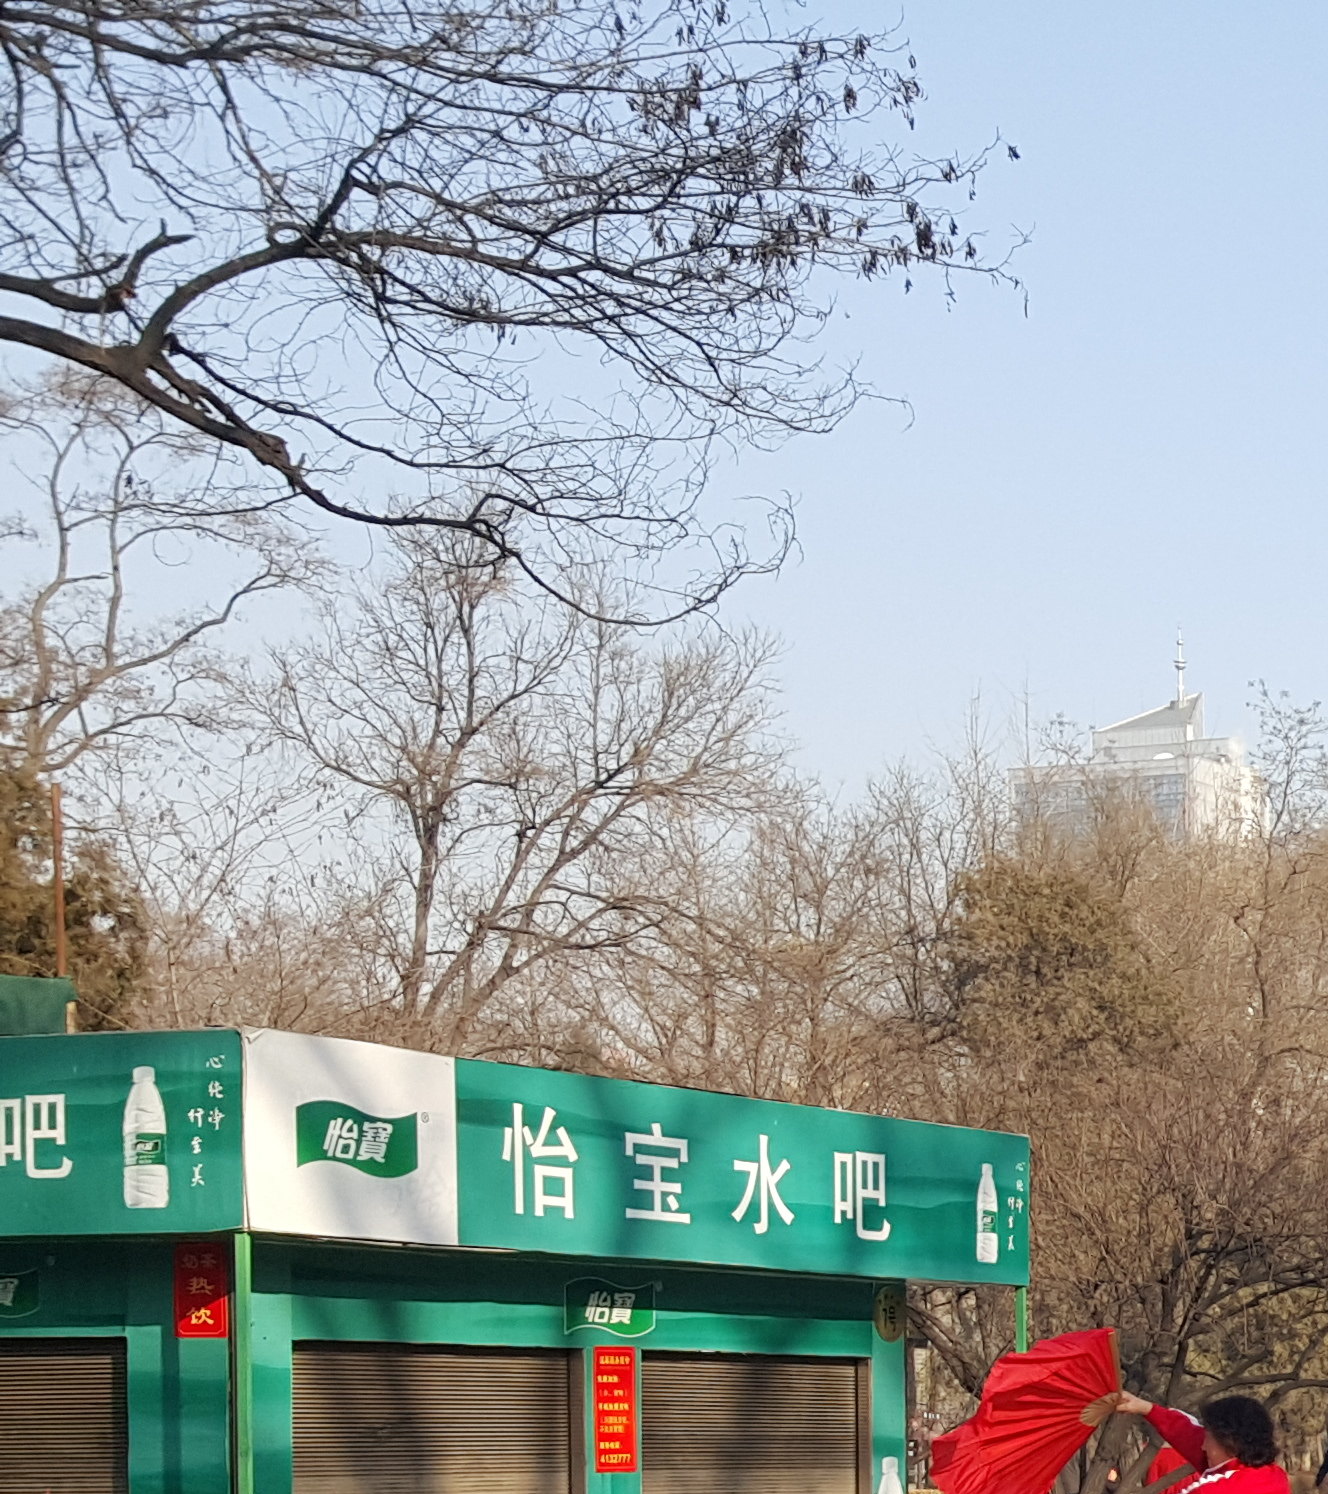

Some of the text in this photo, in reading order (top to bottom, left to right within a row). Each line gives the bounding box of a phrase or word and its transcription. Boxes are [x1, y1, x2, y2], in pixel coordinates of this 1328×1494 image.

[322, 1117, 394, 1164] 怡寶
[502, 1102, 891, 1241] 怡宝水吧
[584, 1290, 636, 1325] 怡寶
